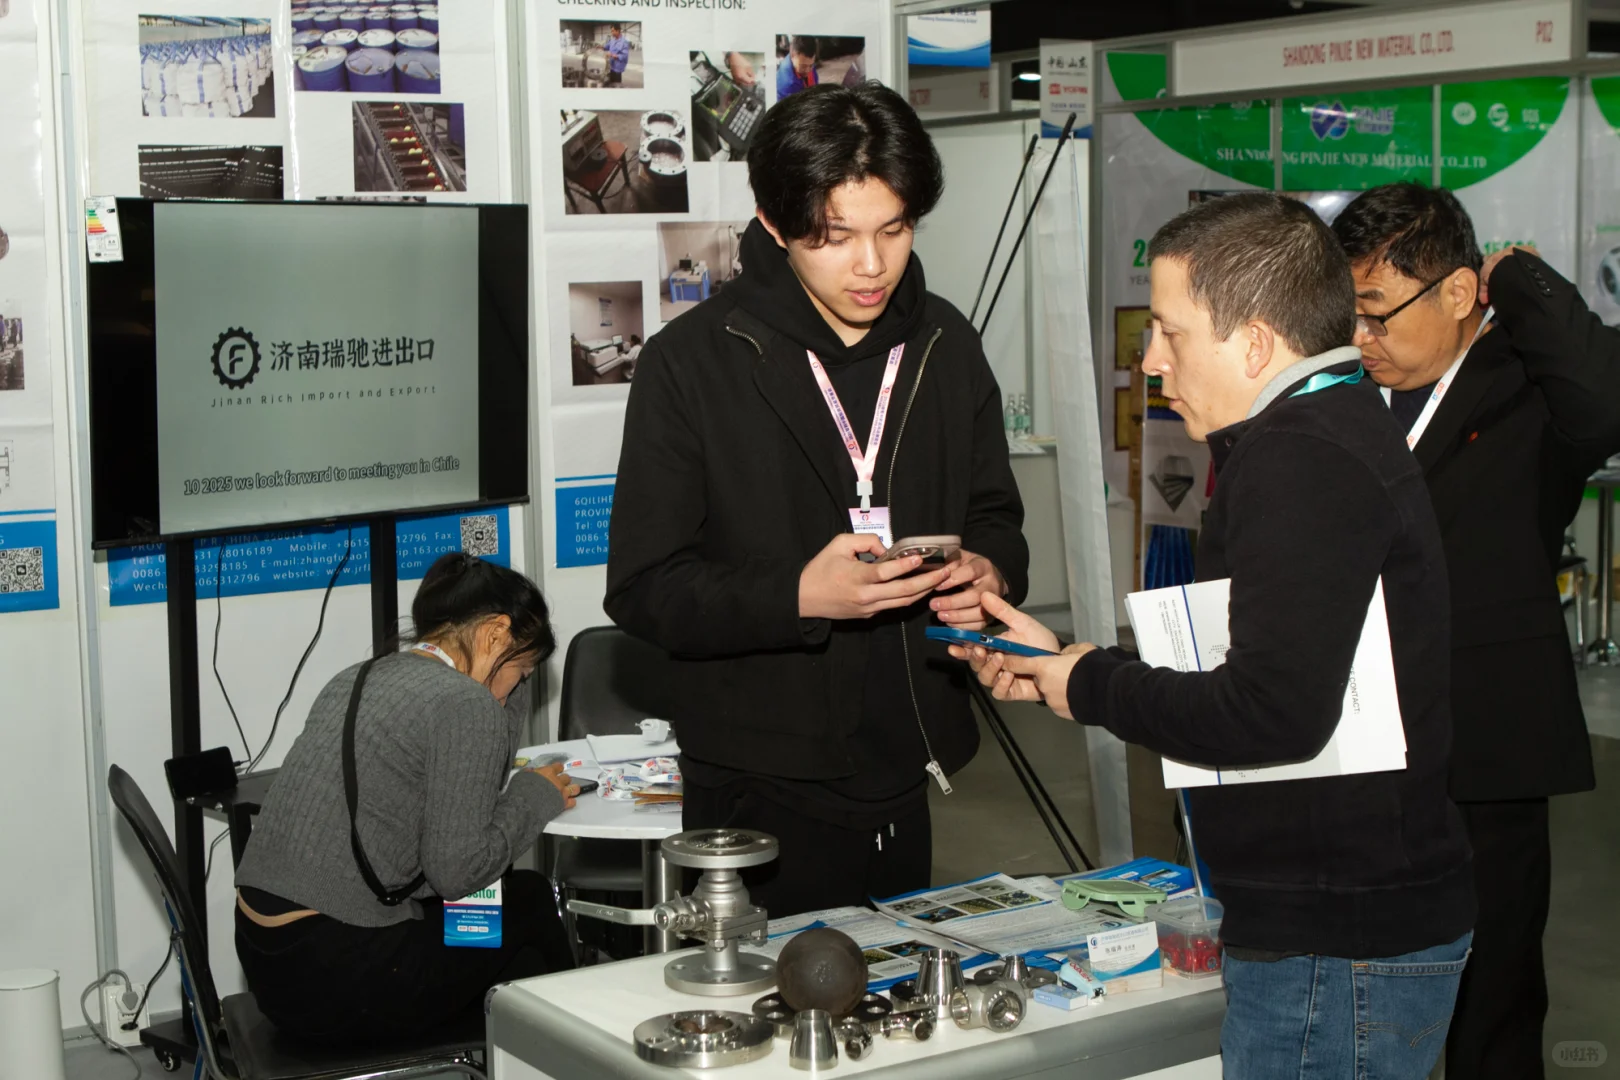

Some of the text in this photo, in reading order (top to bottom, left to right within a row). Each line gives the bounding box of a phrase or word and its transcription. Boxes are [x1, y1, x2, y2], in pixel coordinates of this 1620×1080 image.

[270, 336, 434, 372] 济南瑞驰进出口
[211, 385, 436, 407] Jinan Rich Import and Export
[184, 455, 460, 495] 10 2025 we look forward to meeting you in Chile
[134, 583, 167, 592] Wech
